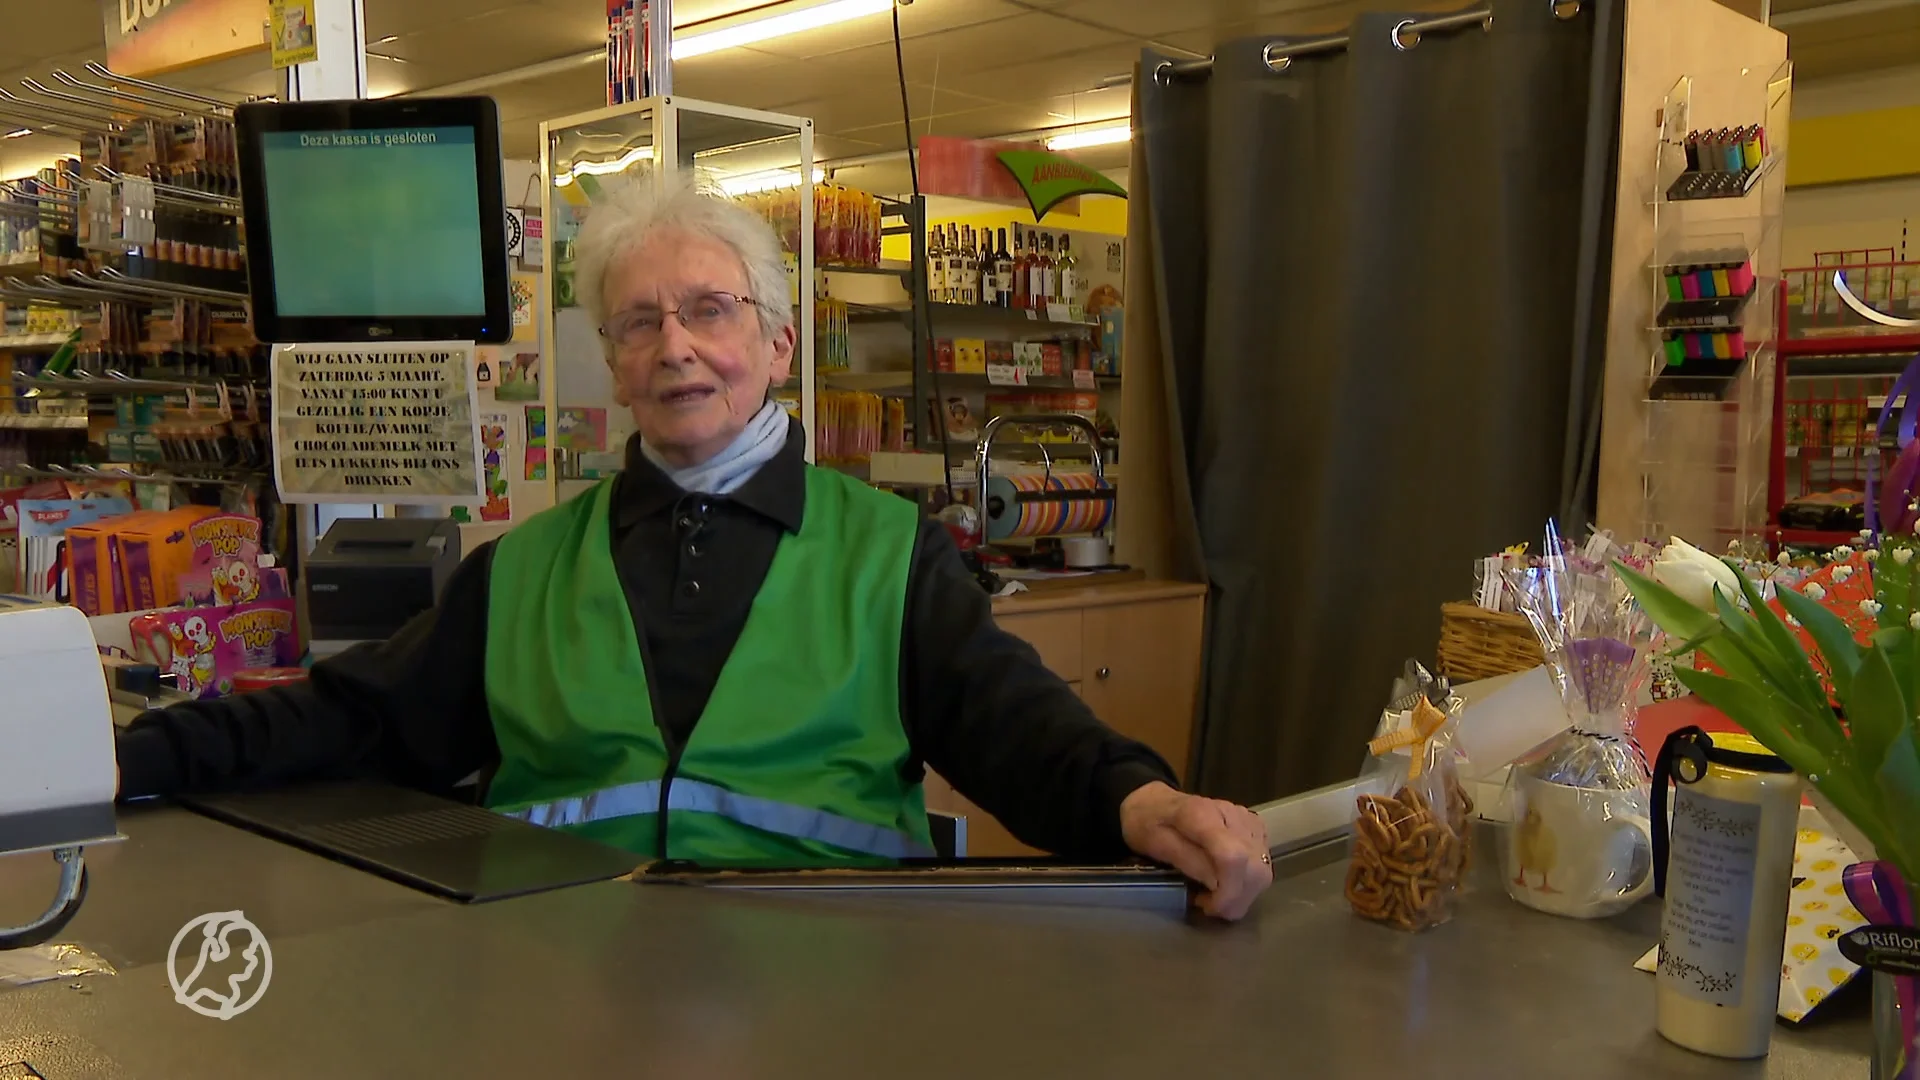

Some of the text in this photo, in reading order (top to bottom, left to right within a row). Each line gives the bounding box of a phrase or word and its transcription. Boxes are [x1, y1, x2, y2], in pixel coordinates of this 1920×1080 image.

[301, 131, 436, 147] Deze kassa is gesloten
[295, 353, 450, 364] WIJ GAAN SLUITEN OP
[299, 370, 445, 382] ZATERDAG 5 MAART.
[301, 388, 443, 399] VANAF 15:00 KUNT U
[296, 406, 450, 417] GEZELLIG EEN KOPJE
[316, 423, 433, 435] KOFFIE/WARME
[294, 441, 458, 452] CHOCOLADEMELK MET
[295, 458, 460, 469] IETS LEKKERS BIJ ONS
[344, 475, 412, 486] DRINKEN
[212, 536, 241, 556] POP
[243, 629, 274, 650] POP
